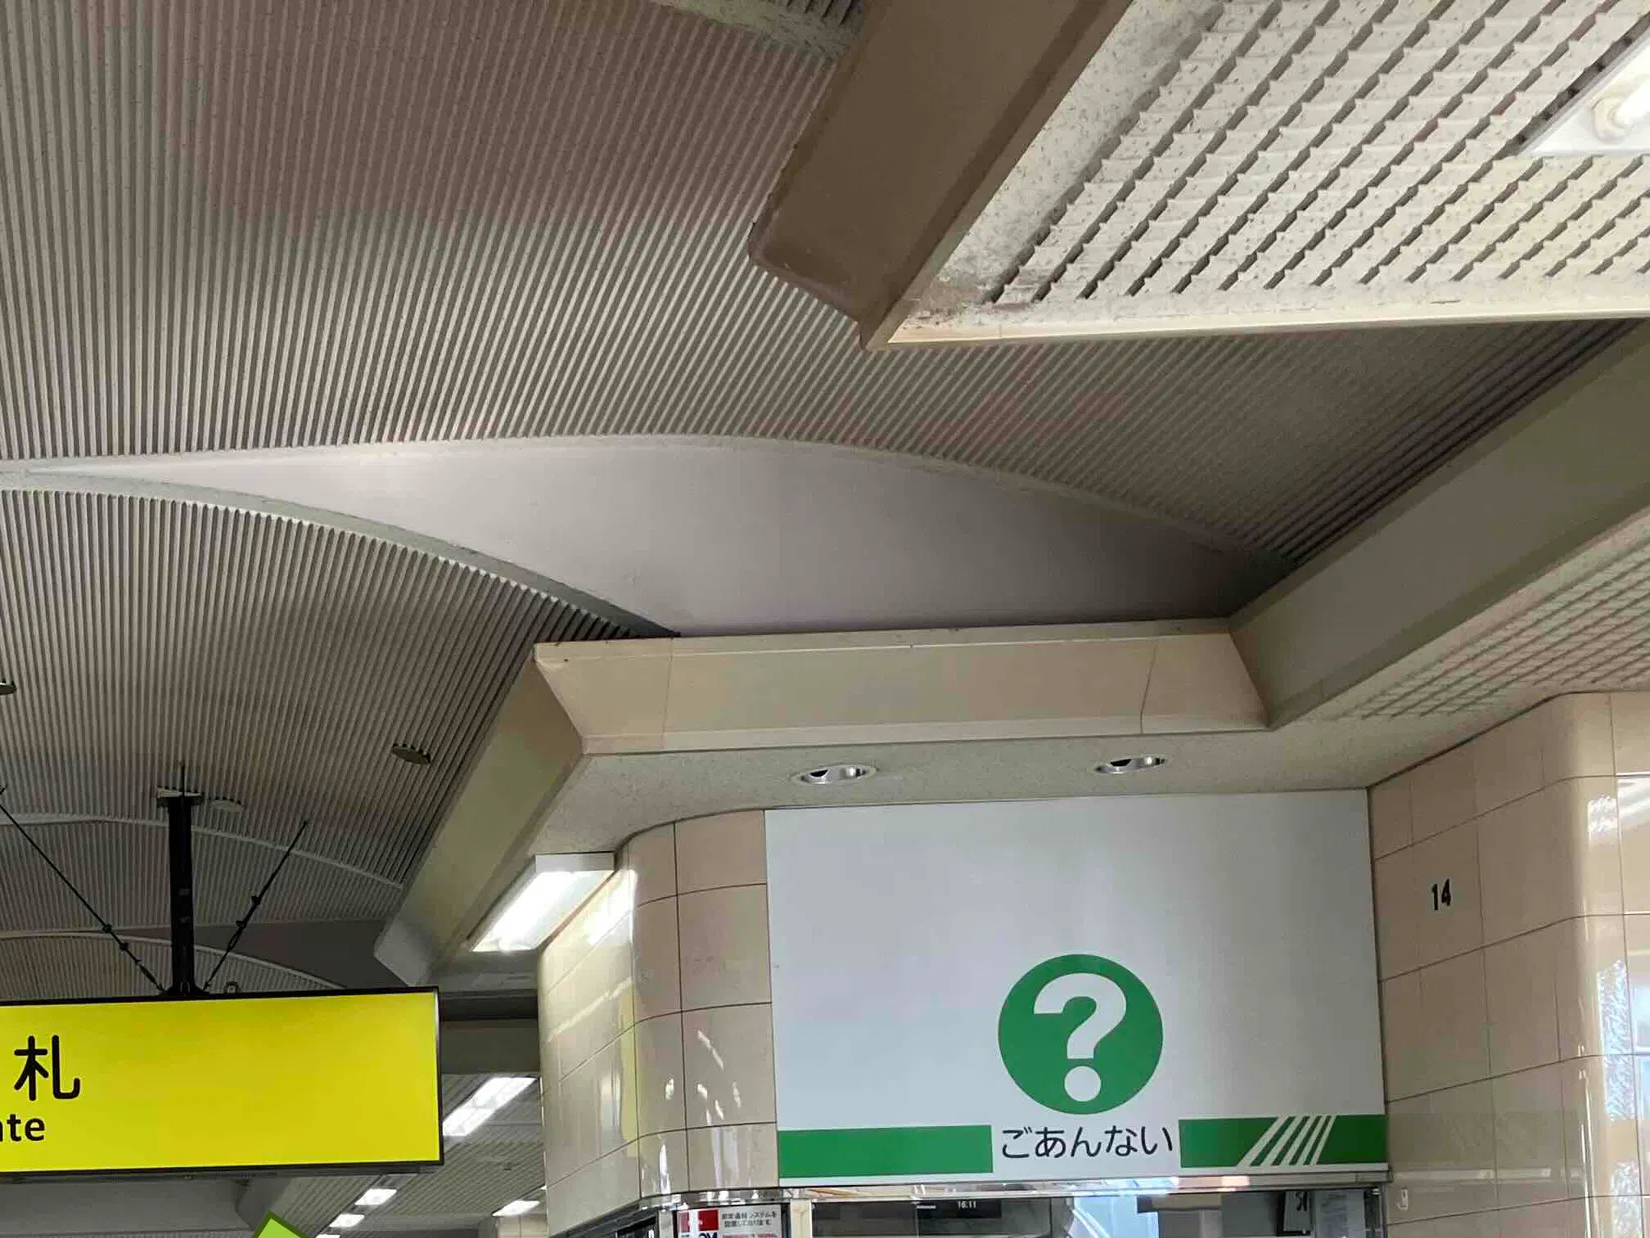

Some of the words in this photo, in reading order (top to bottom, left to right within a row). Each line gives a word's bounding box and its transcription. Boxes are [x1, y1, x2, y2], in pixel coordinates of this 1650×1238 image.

[1431, 878, 1452, 911] 14
[1000, 1124, 1174, 1161] ごあんない
